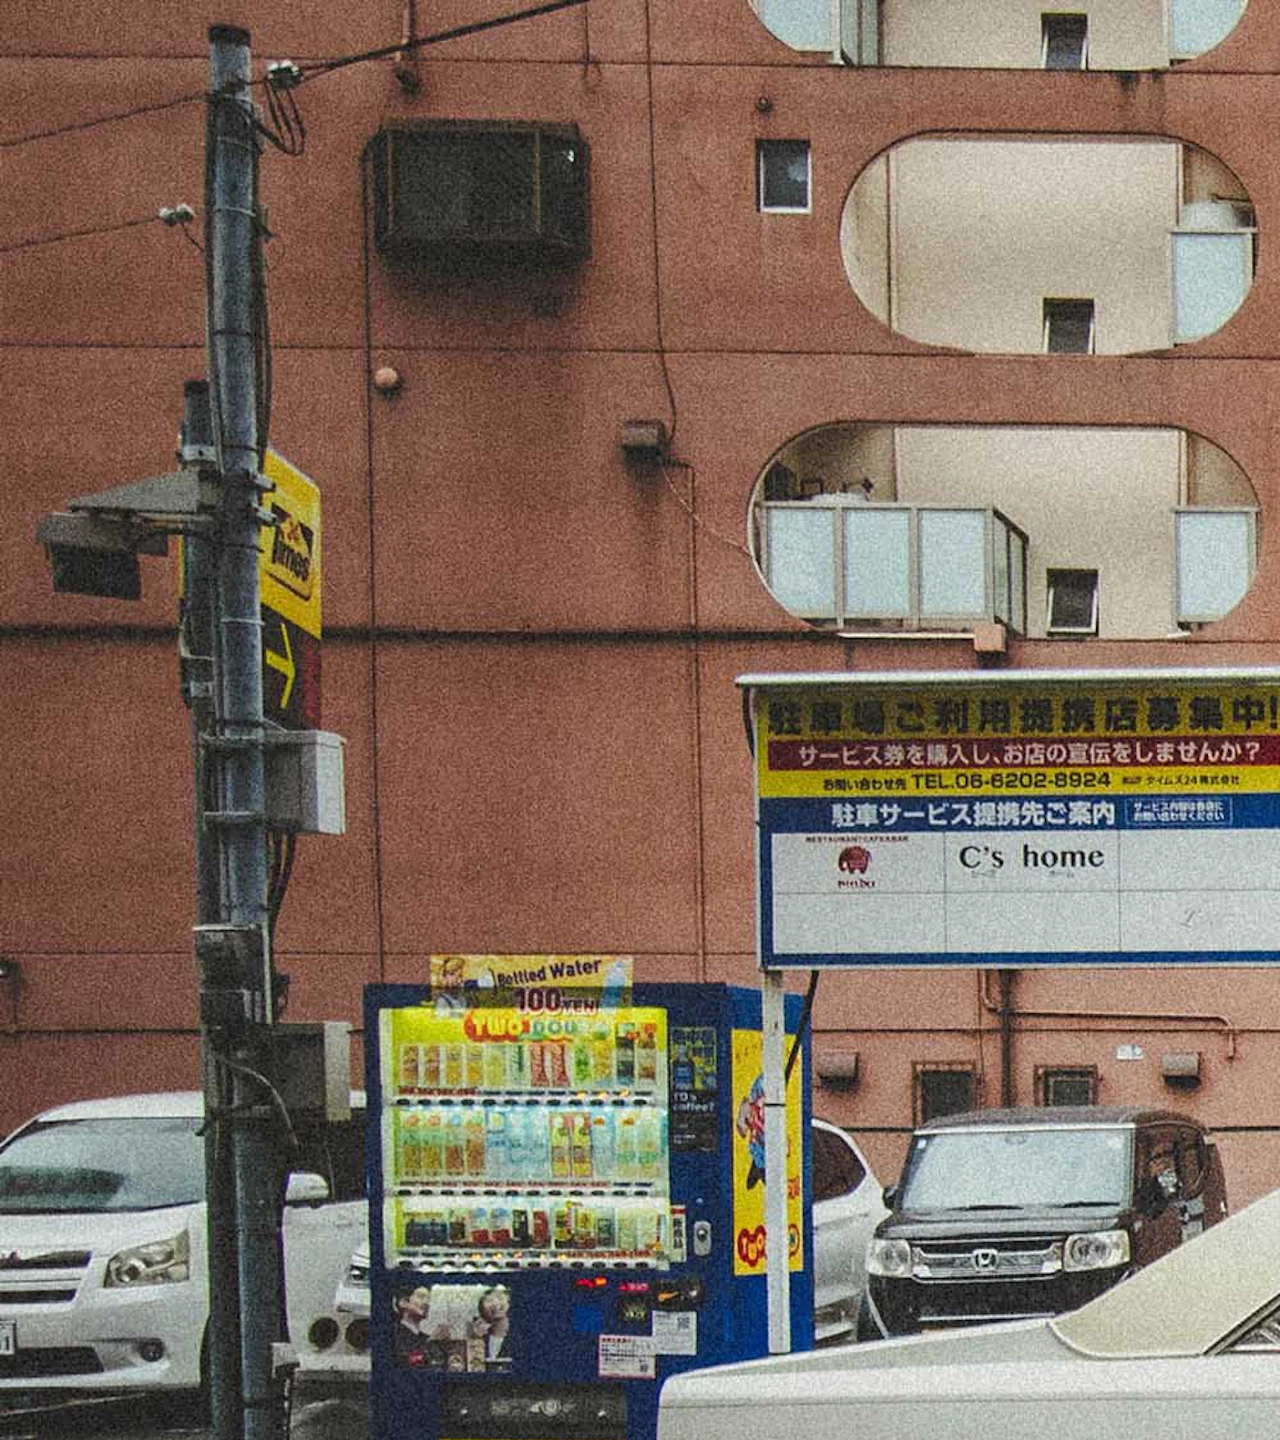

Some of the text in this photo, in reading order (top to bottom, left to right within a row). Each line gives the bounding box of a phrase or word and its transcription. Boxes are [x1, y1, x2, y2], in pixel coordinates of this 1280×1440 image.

[911, 772, 1111, 791] TEL.06-6202-8924
[831, 801, 1116, 828] 駐車サービス提携先ご案内
[959, 843, 1105, 868] C's home
[497, 959, 602, 987] Bottled Water
